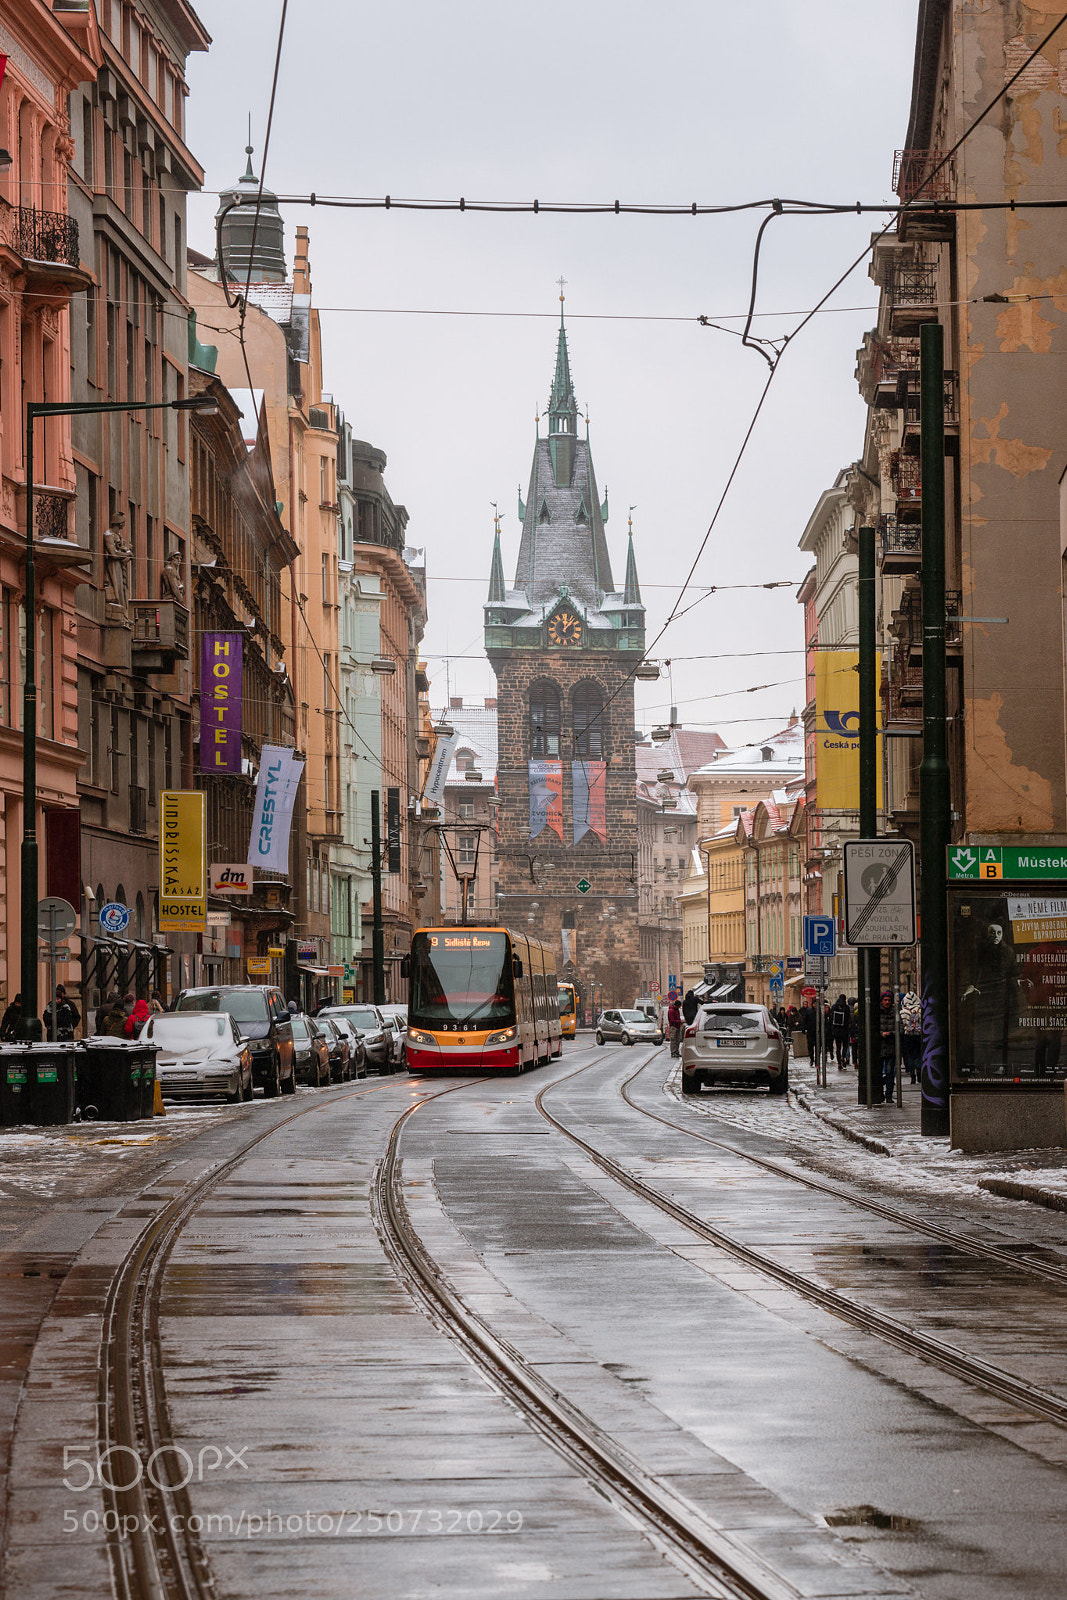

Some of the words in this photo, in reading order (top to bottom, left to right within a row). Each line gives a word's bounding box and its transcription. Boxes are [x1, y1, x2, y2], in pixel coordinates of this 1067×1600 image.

[213, 641, 230, 766] HOSTEL
[823, 739, 849, 749] Česká
[430, 748, 448, 794] Hypocentrum
[258, 759, 282, 855] CRESTYL
[165, 795, 180, 885] JINDŘIŠSKÁ
[850, 846, 874, 858] PĚŠÍ
[985, 848, 996, 861] A
[1018, 856, 1067, 868] Můstek
[220, 867, 245, 882] dm
[986, 865, 997, 878] B
[164, 886, 200, 895] PASÁŽ
[162, 905, 204, 916] HOSTEL
[1028, 900, 1048, 914] NĚMÉ
[813, 923, 829, 945] P
[430, 936, 439, 947] 9
[1018, 1016, 1048, 1027] POSLEDNÍ
